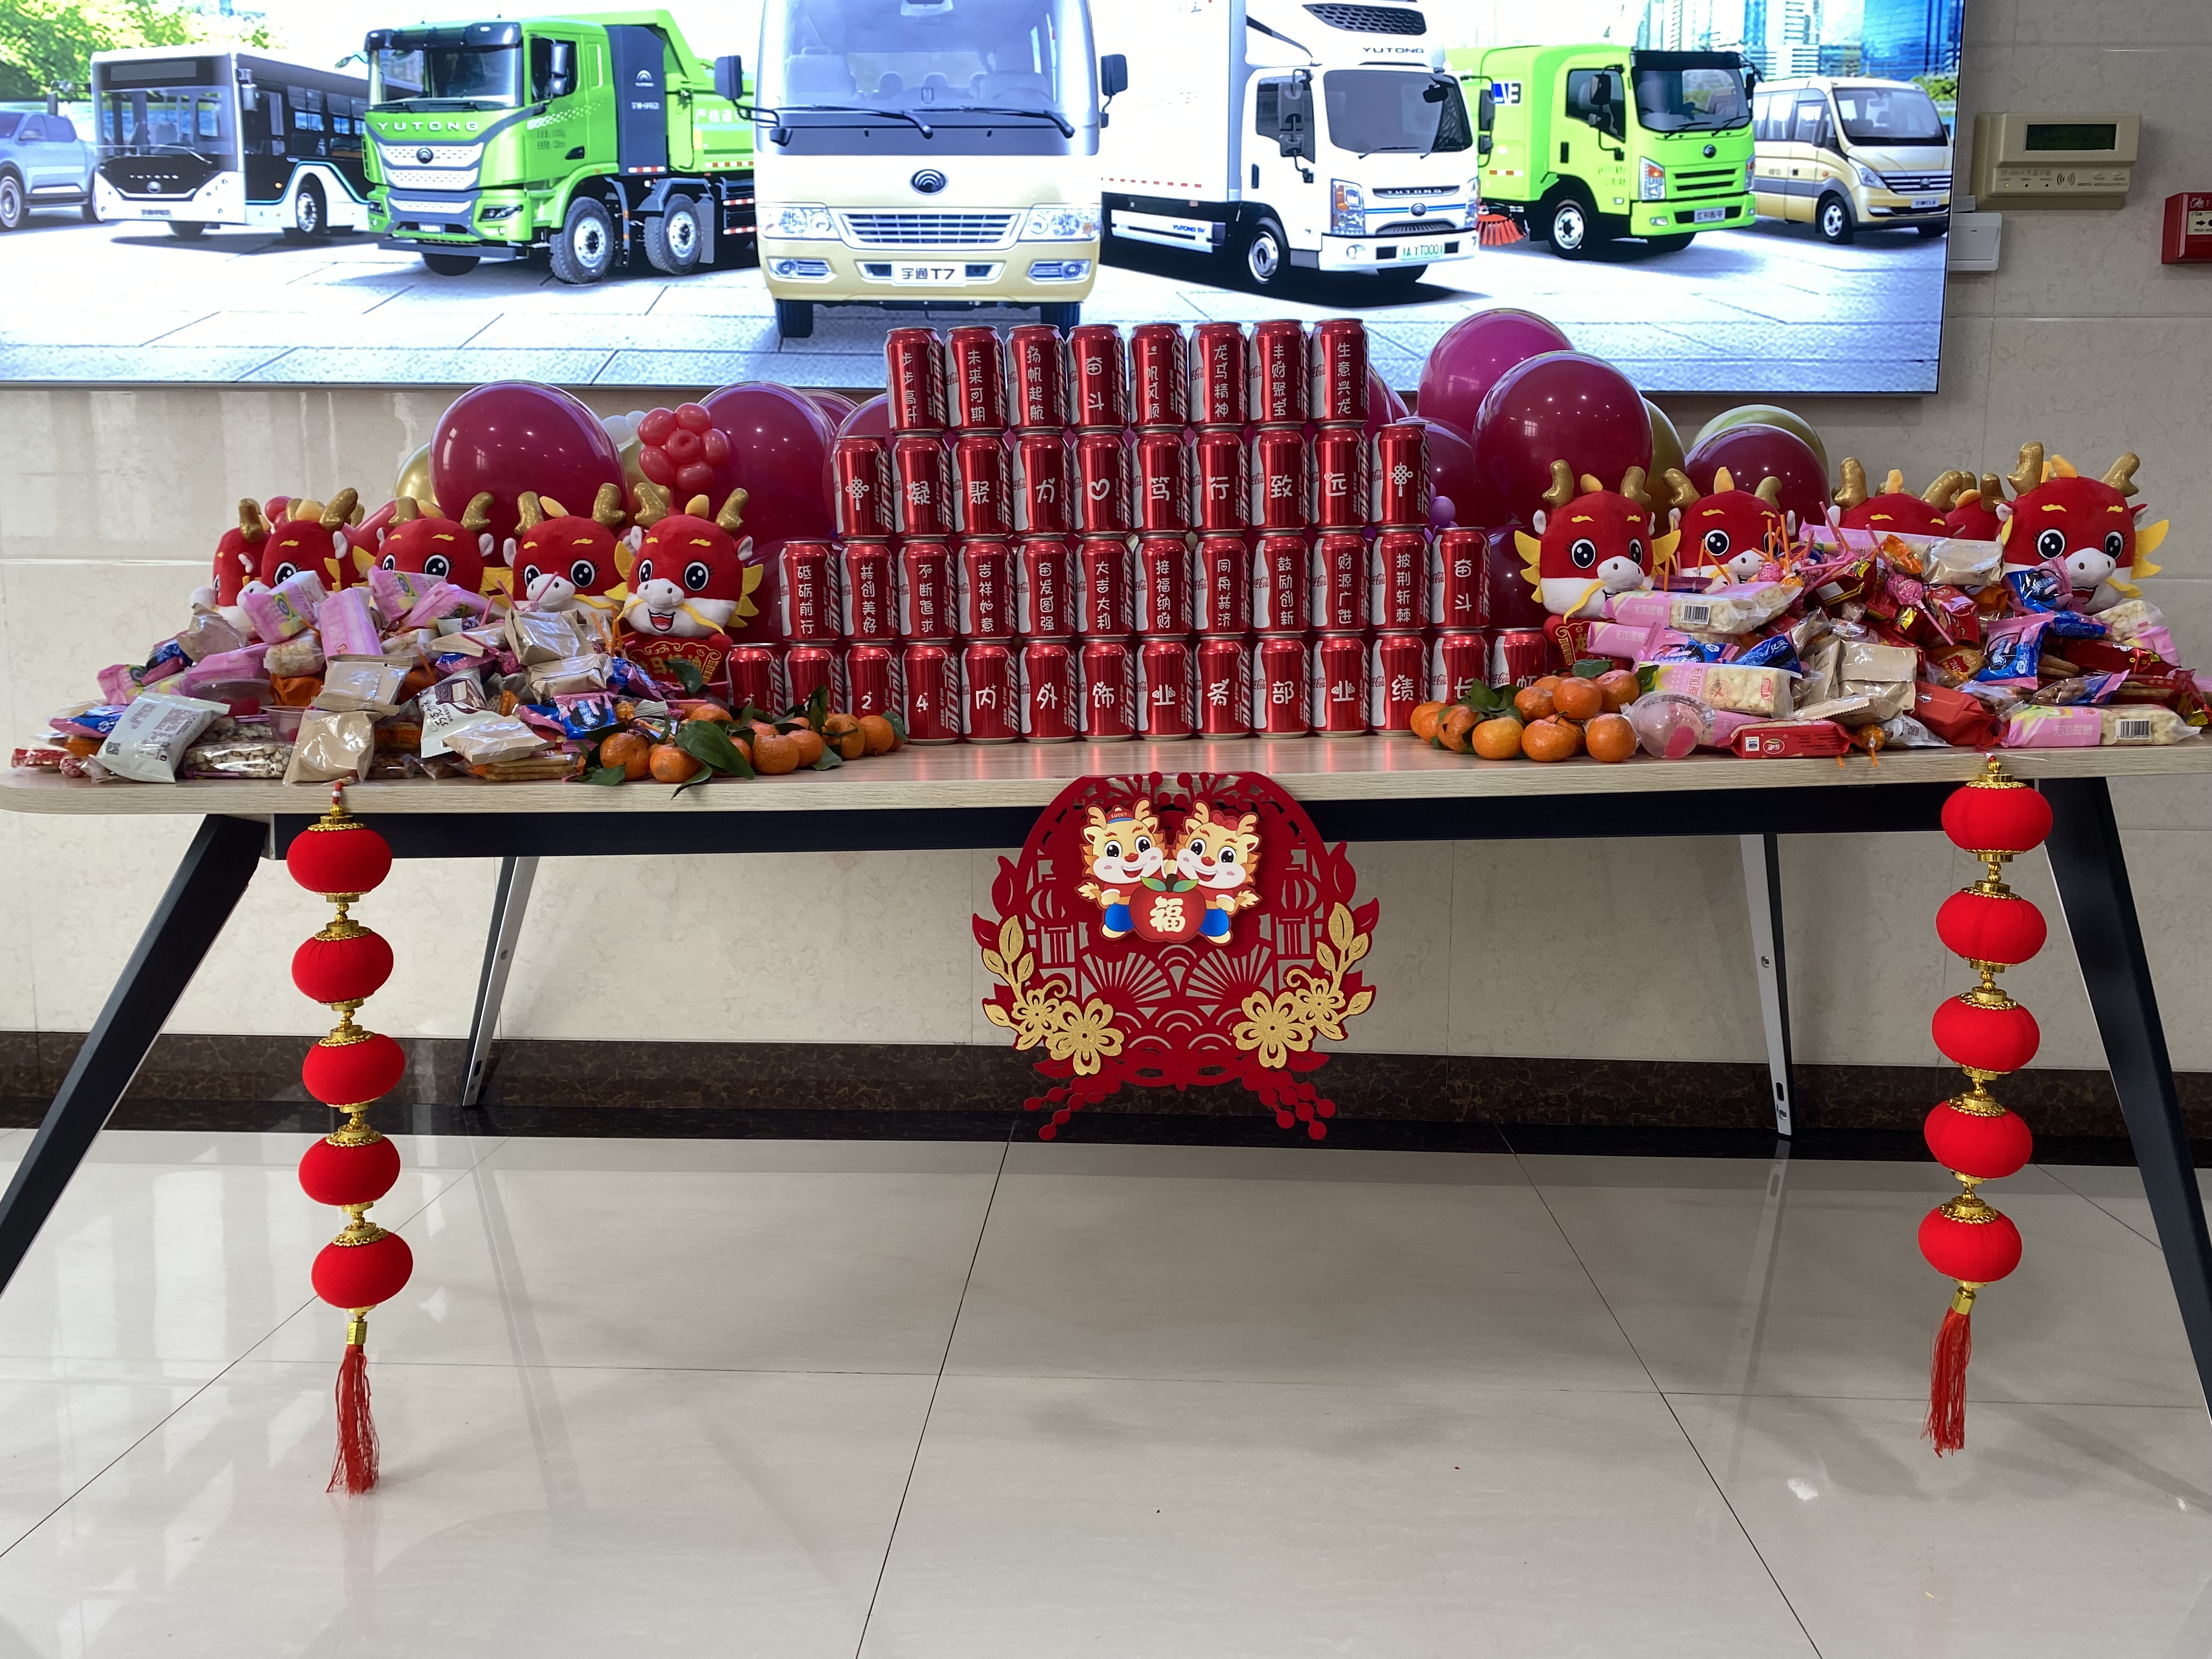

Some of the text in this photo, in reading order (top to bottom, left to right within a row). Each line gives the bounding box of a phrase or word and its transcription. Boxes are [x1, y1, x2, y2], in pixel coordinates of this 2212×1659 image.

[377, 121, 478, 131] YUTONG
[900, 352, 918, 424] 步步高升
[967, 349, 986, 423] 未来可期
[1026, 345, 1045, 421] 扬帆起航
[1085, 356, 1105, 411] 奋斗
[1144, 343, 1159, 420] 一帆风顺
[1214, 344, 1229, 418] 龙马精神
[1337, 342, 1351, 414] 生意兴龙
[906, 481, 930, 506] 凝
[968, 481, 990, 505] 聚
[1150, 476, 1170, 501] 笃
[1208, 476, 1229, 501] 行
[1270, 474, 1293, 499] 致
[1323, 469, 1347, 499] 远
[797, 565, 814, 634] 砥砺前行
[860, 562, 877, 634] 共创美好
[918, 564, 934, 633] 不断追求
[978, 561, 994, 633] 吉祥如意
[1038, 562, 1054, 631] 奋发图强
[1096, 561, 1110, 630] 大吉大利
[1155, 560, 1171, 629] 接福纳财
[1217, 558, 1231, 627] 同舟共济
[1277, 556, 1294, 625] 鼓励创新
[1338, 552, 1352, 624] 财源广进
[1396, 552, 1410, 623] 披荆斩棘
[1454, 558, 1472, 612] 奋斗
[1634, 604, 1664, 616] 无加蔗糖
[1615, 629, 1646, 642] 无加蔗糖
[861, 695, 872, 710] 2
[916, 694, 929, 711] 4
[975, 684, 996, 709] 内
[1036, 682, 1058, 709] 外
[1092, 681, 1114, 708] 饰
[1152, 684, 1176, 706] 业
[1207, 678, 1229, 706] 务
[1272, 680, 1294, 704] 部
[1331, 680, 1355, 702] 业
[1391, 674, 1414, 702] 绩
[2053, 724, 2094, 737] 无加蔗糖
[1149, 895, 1186, 933] 福
